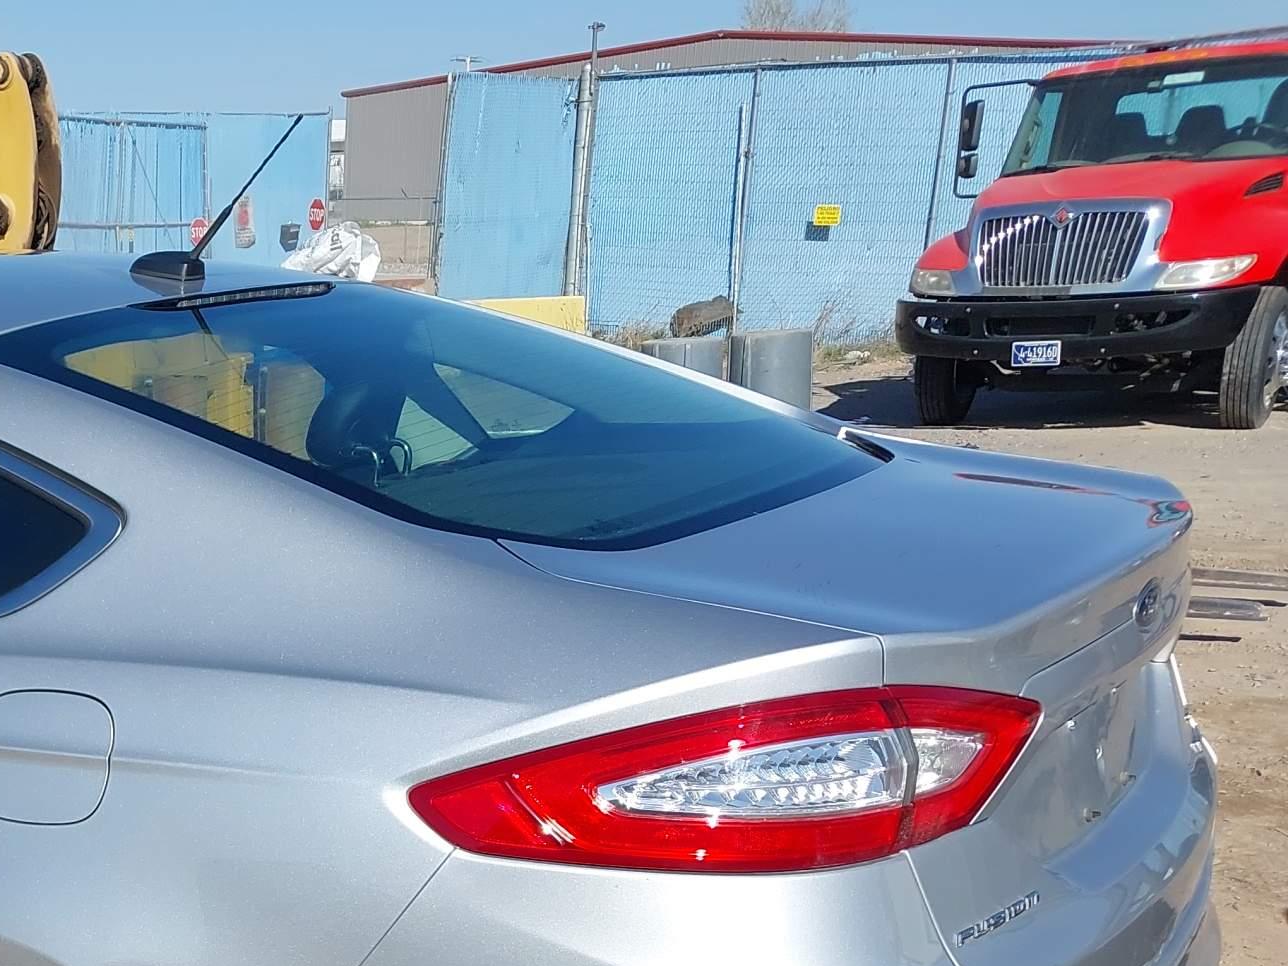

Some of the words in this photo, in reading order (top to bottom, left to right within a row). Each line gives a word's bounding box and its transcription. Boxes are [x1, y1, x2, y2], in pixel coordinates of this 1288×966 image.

[309, 207, 325, 222] STOP
[191, 226, 207, 239] STOP
[953, 889, 1040, 948] FUSION
